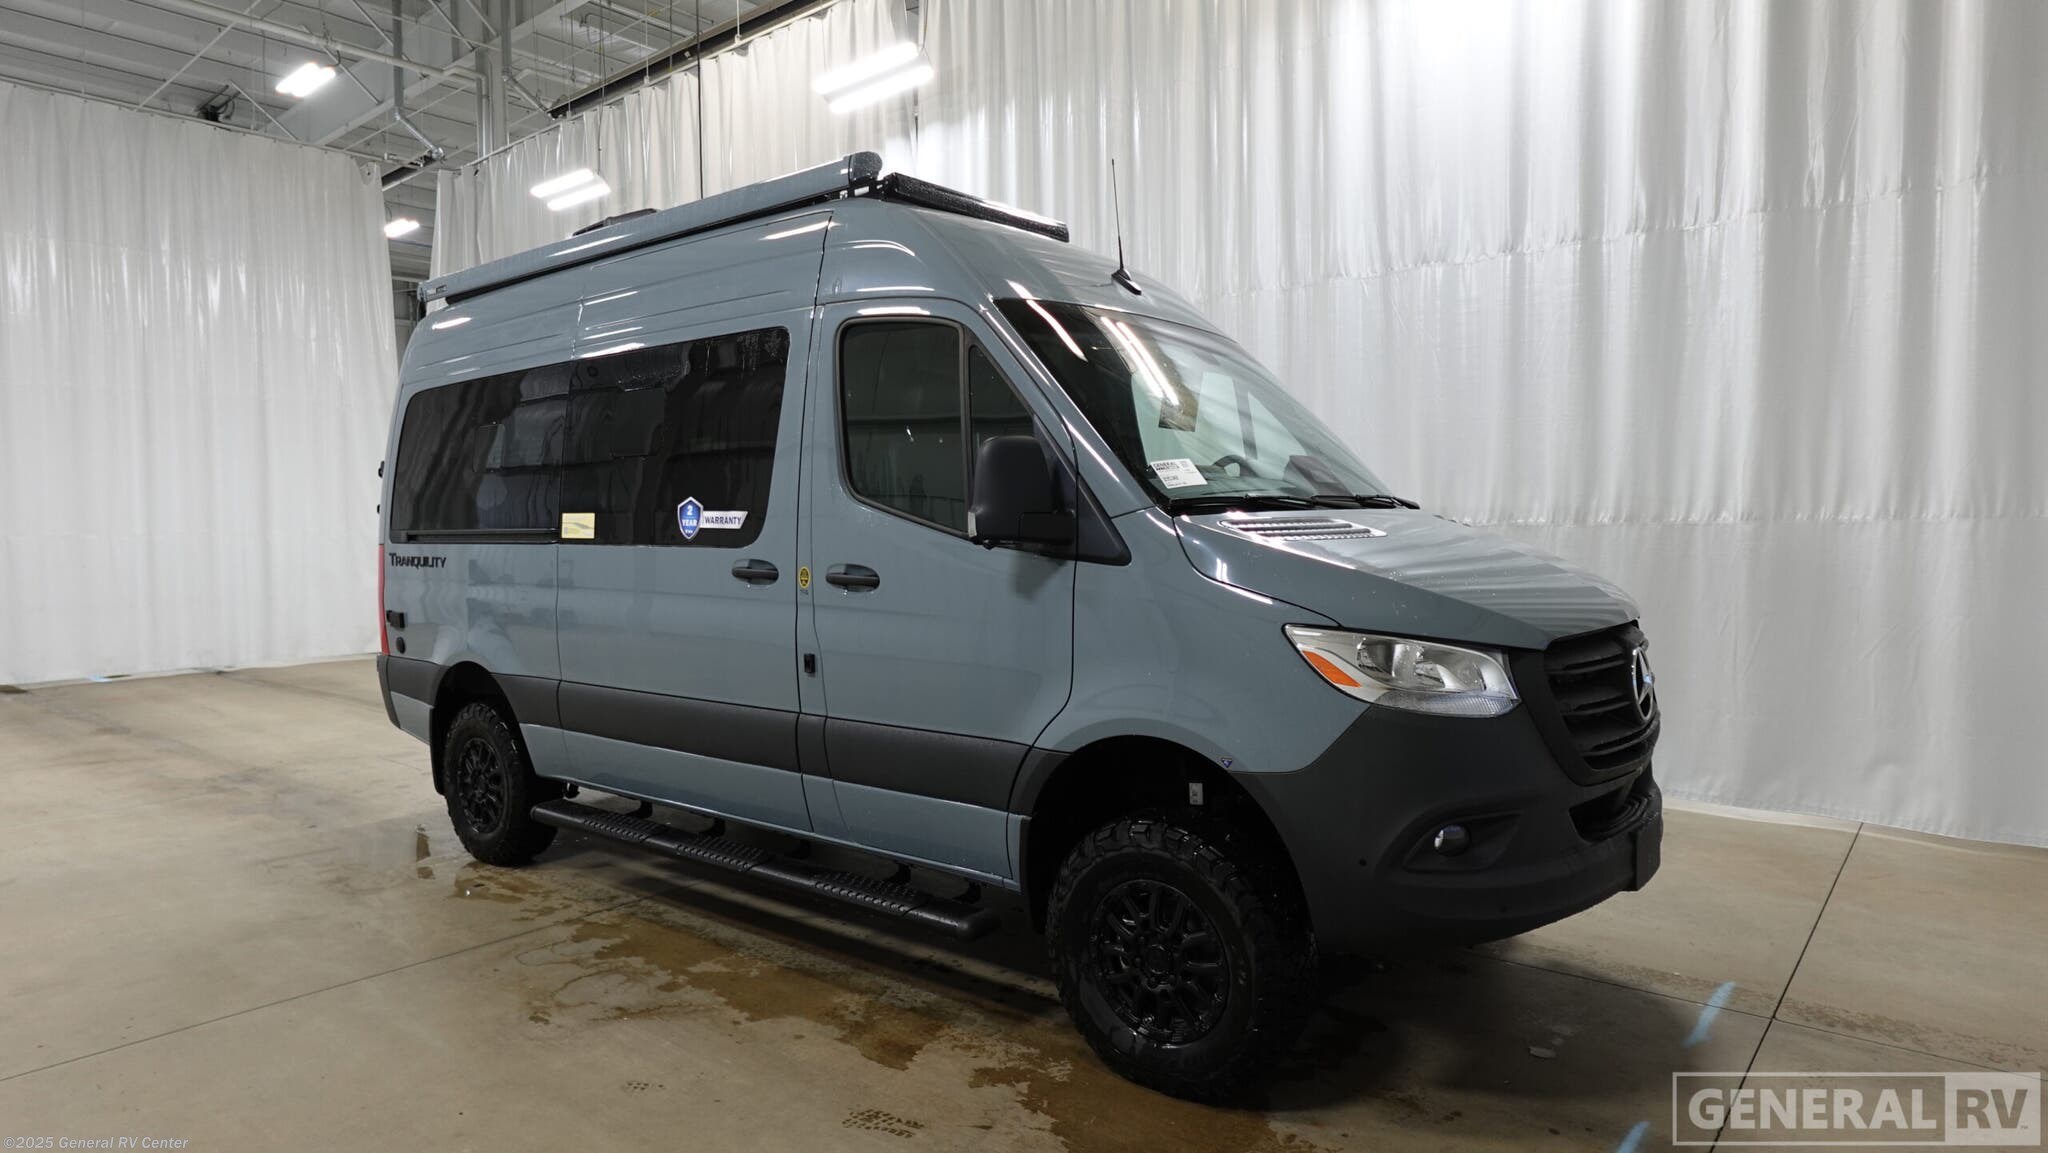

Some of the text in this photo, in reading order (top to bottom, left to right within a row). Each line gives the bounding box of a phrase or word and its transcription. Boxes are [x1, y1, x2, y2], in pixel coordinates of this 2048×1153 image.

[686, 504, 693, 515] 2
[682, 519, 698, 527] YEAR
[705, 515, 742, 525] WARRANTY
[389, 552, 447, 569] TRANQUILITY
